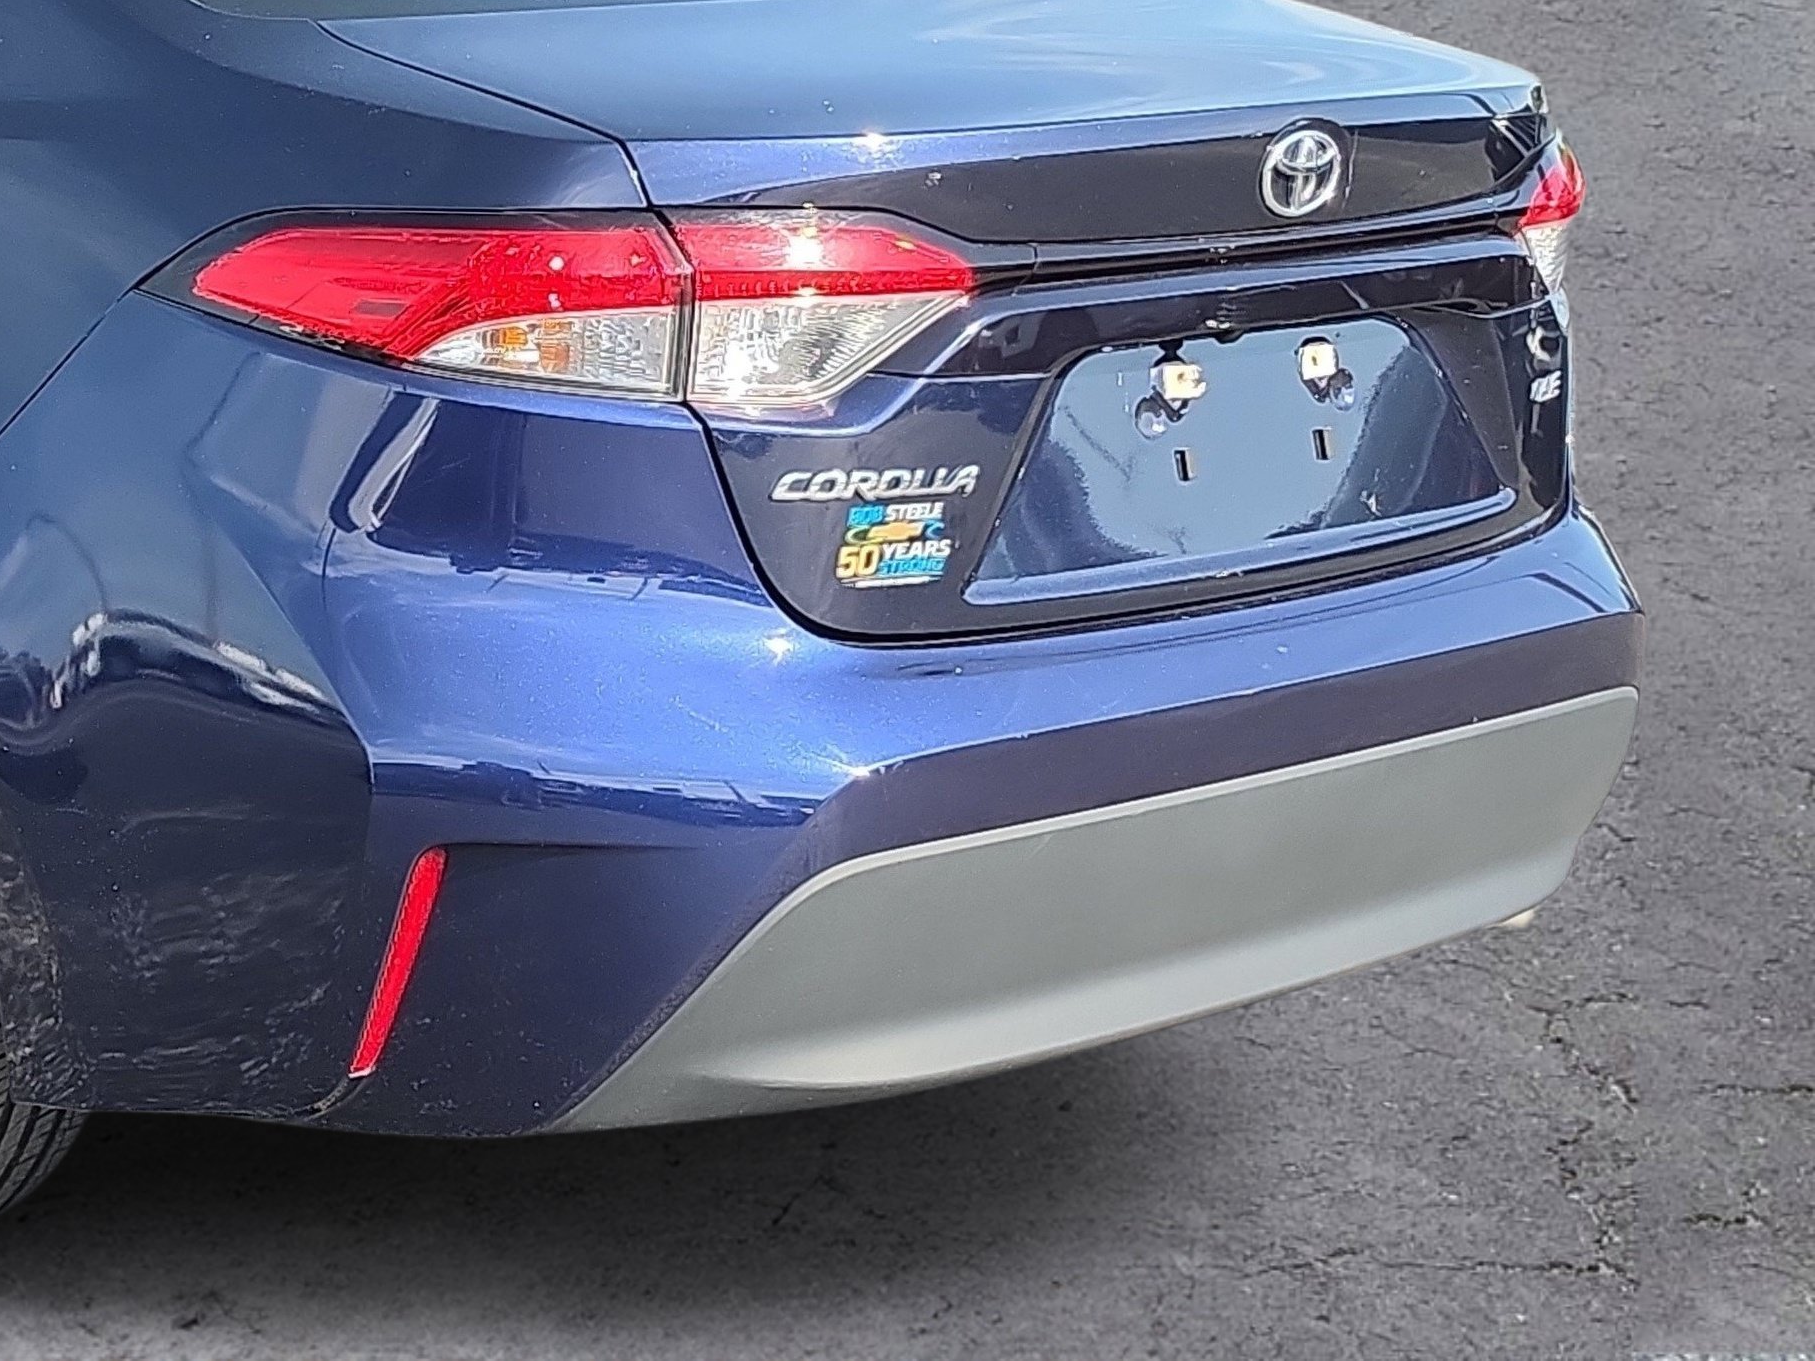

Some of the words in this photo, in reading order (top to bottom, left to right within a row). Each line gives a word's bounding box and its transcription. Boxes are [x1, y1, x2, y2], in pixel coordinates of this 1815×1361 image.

[770, 464, 981, 501] COROLLA
[885, 502, 945, 521] STEELE
[835, 544, 882, 578] 50
[882, 539, 952, 560] YEARS
